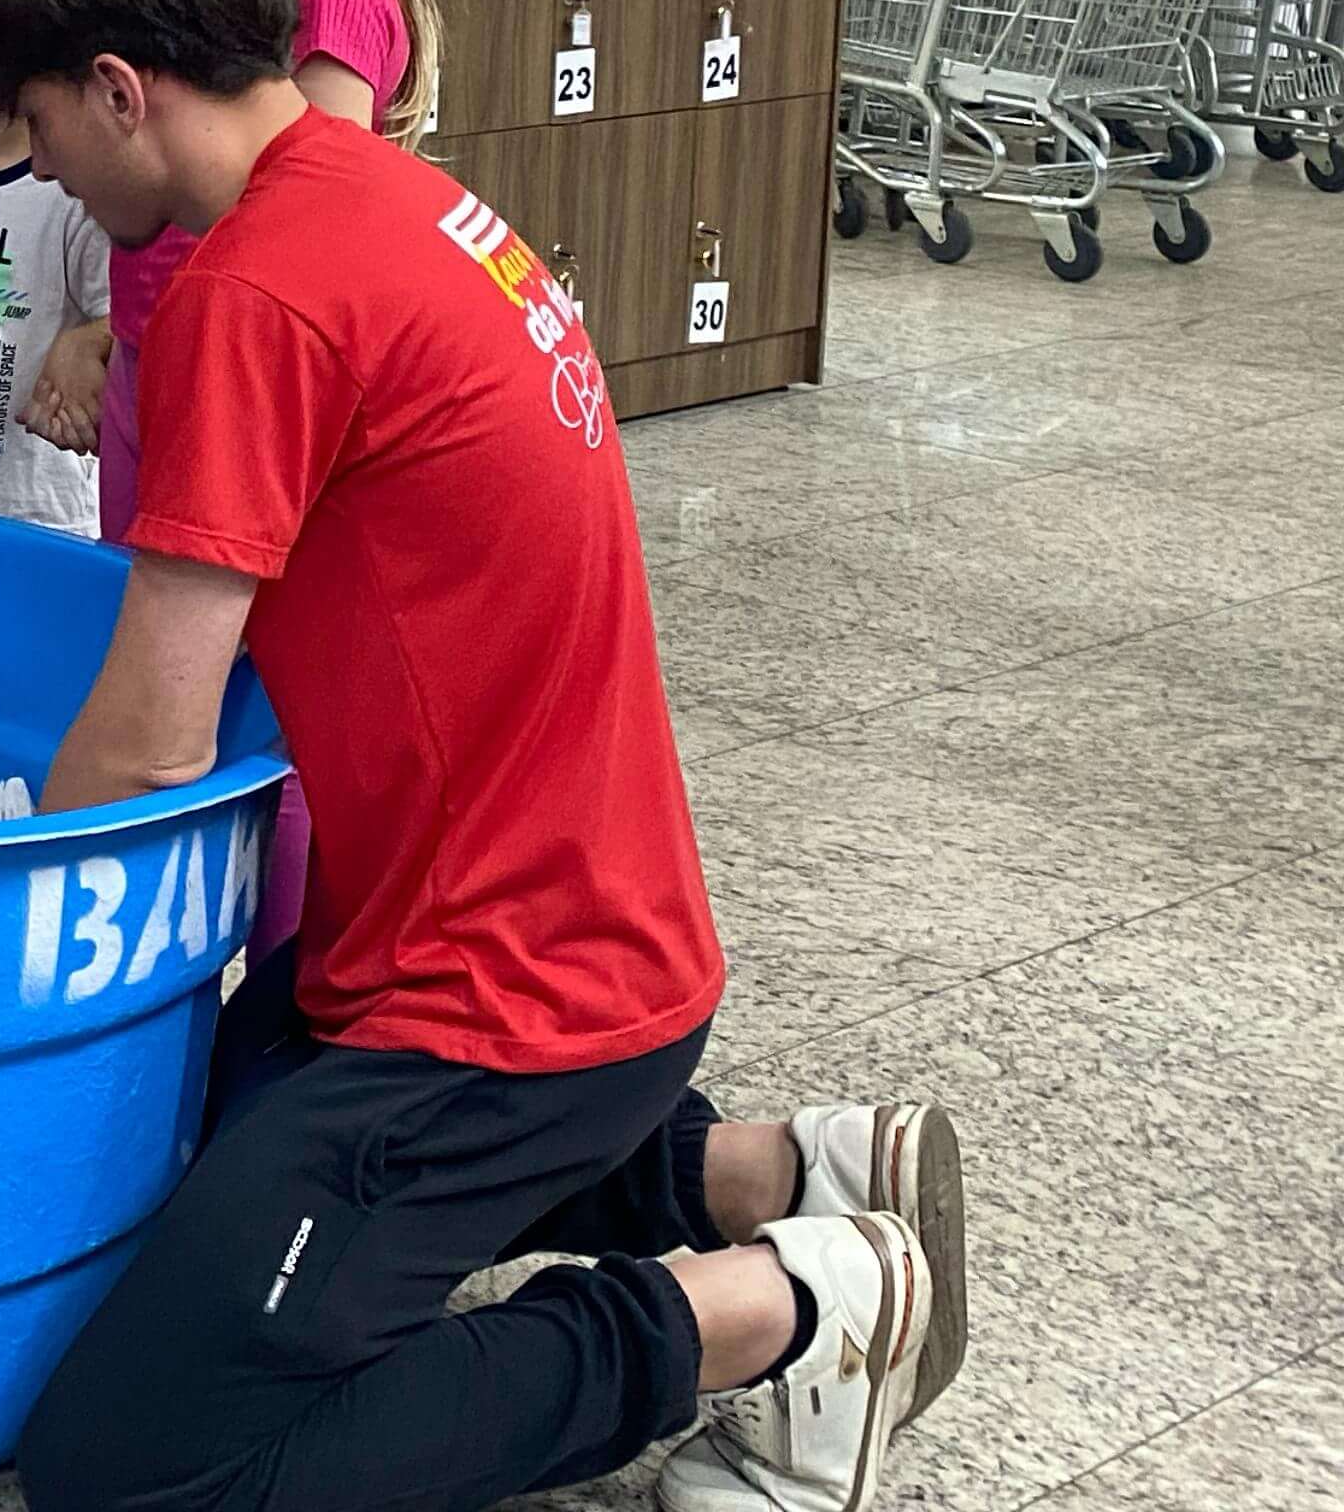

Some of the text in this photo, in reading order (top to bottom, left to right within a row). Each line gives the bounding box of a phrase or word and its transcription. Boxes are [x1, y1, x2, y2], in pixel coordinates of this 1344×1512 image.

[558, 67, 592, 102] 23
[706, 54, 737, 87] 24
[693, 298, 724, 331] 30
[0, 342, 17, 377] SPACE
